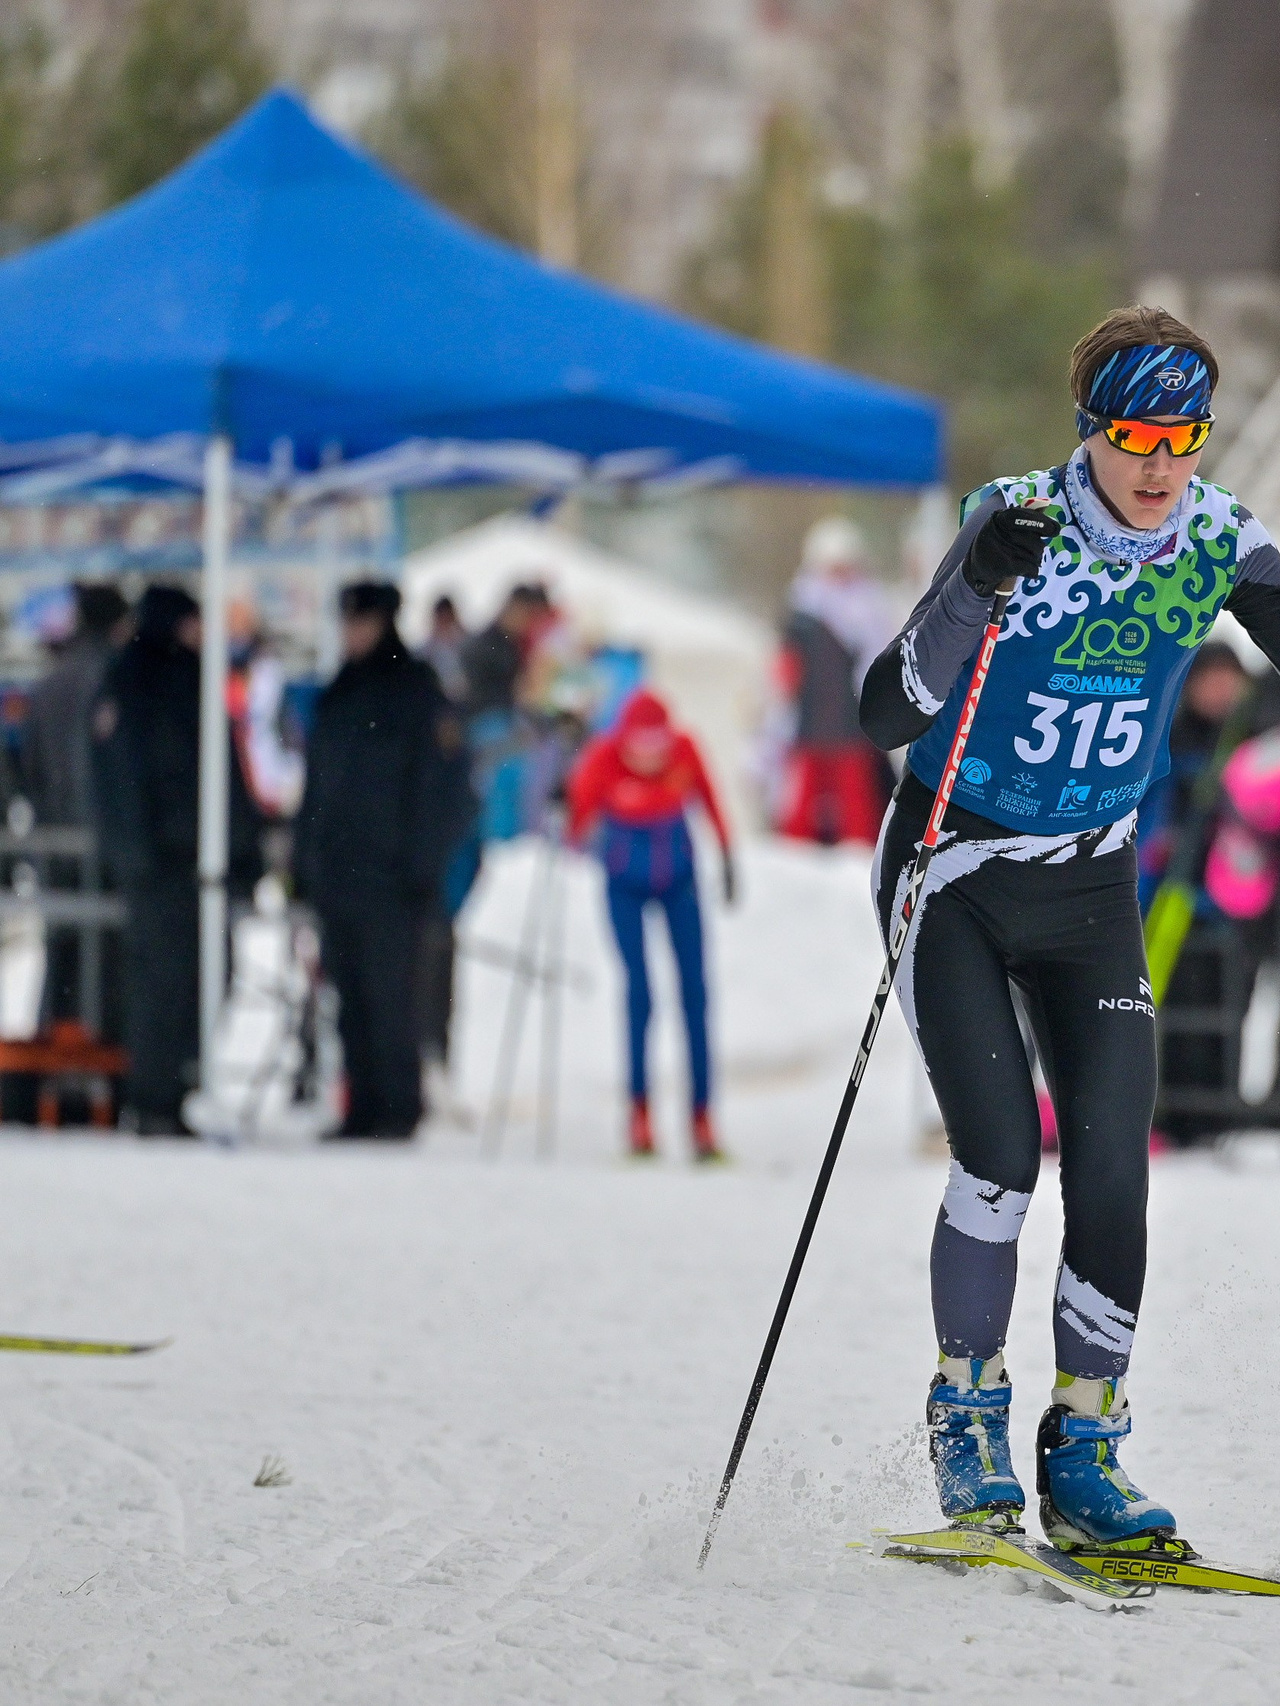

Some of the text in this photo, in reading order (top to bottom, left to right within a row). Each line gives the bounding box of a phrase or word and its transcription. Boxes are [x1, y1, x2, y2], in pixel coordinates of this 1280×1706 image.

[1053, 616, 1150, 671] 400
[1080, 675, 1144, 692] KAMAZ
[1014, 691, 1150, 769] 315
[995, 800, 1026, 816] ГОНОК
[997, 794, 1039, 812] ЛЫЖНЫХ
[1100, 1560, 1178, 1580] FISCHER
